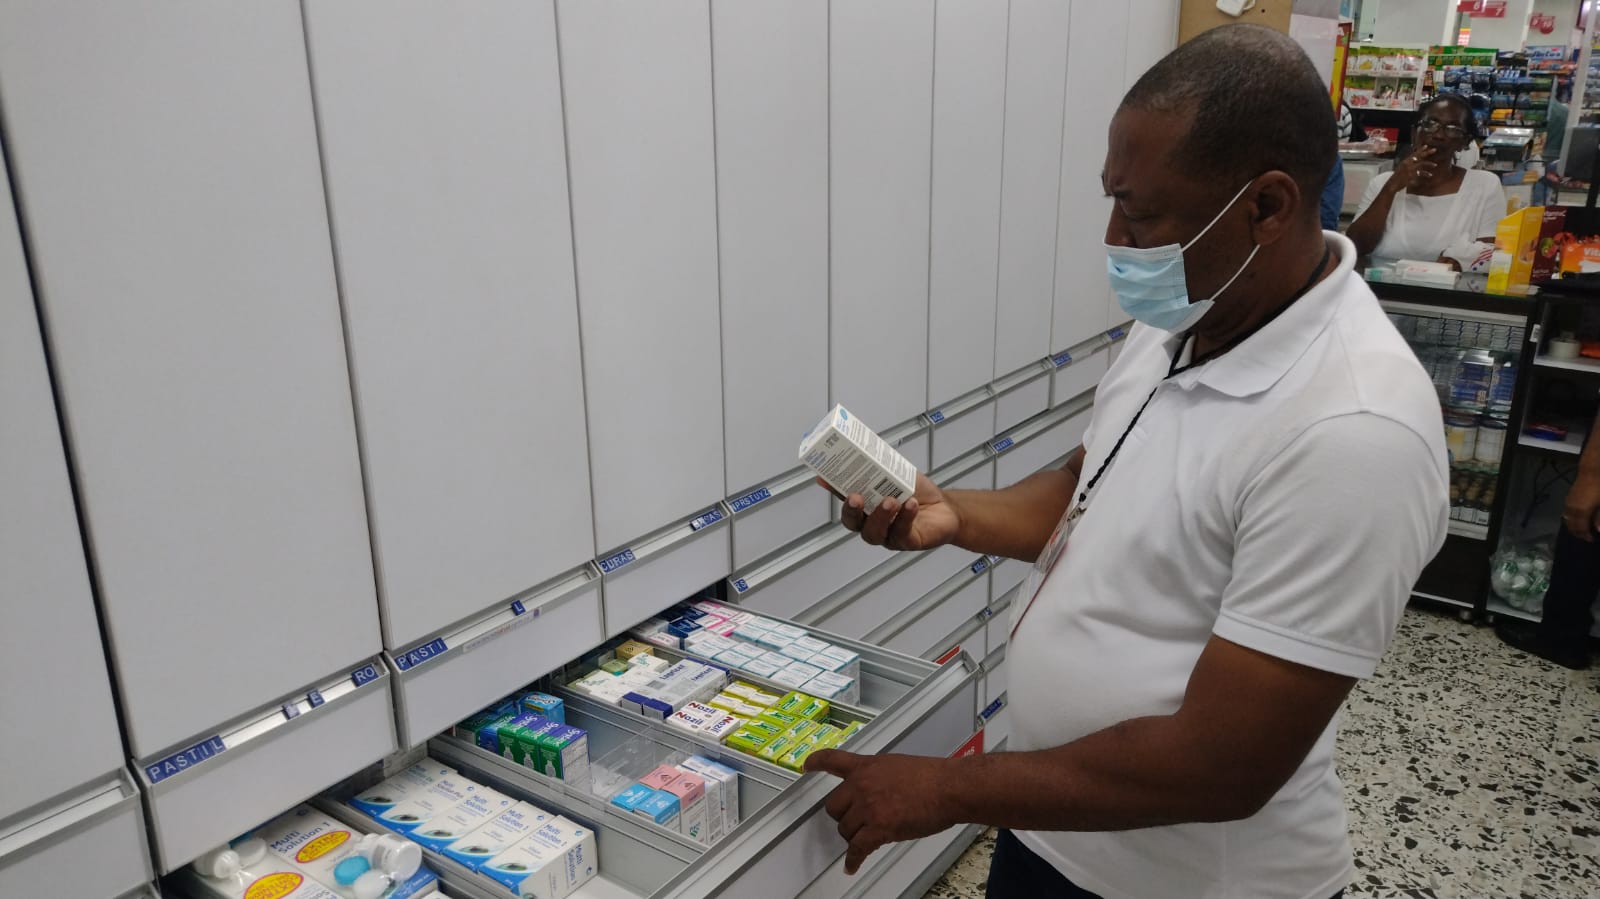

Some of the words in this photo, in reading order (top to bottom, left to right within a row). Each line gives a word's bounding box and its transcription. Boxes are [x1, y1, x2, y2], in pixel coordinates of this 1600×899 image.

[600, 550, 634, 572] CURAS
[398, 640, 443, 668] PASTI
[514, 602, 524, 612] L
[688, 702, 717, 715] Nozil
[150, 738, 224, 780] PASTIL
[355, 666, 375, 682] RO
[675, 711, 704, 726] Nozil
[711, 716, 734, 733] Nozil
[537, 829, 561, 844] Solution
[544, 824, 561, 835] Multi
[271, 830, 301, 849] Multi
[278, 827, 323, 853] Solution
[575, 843, 583, 865] Multi
